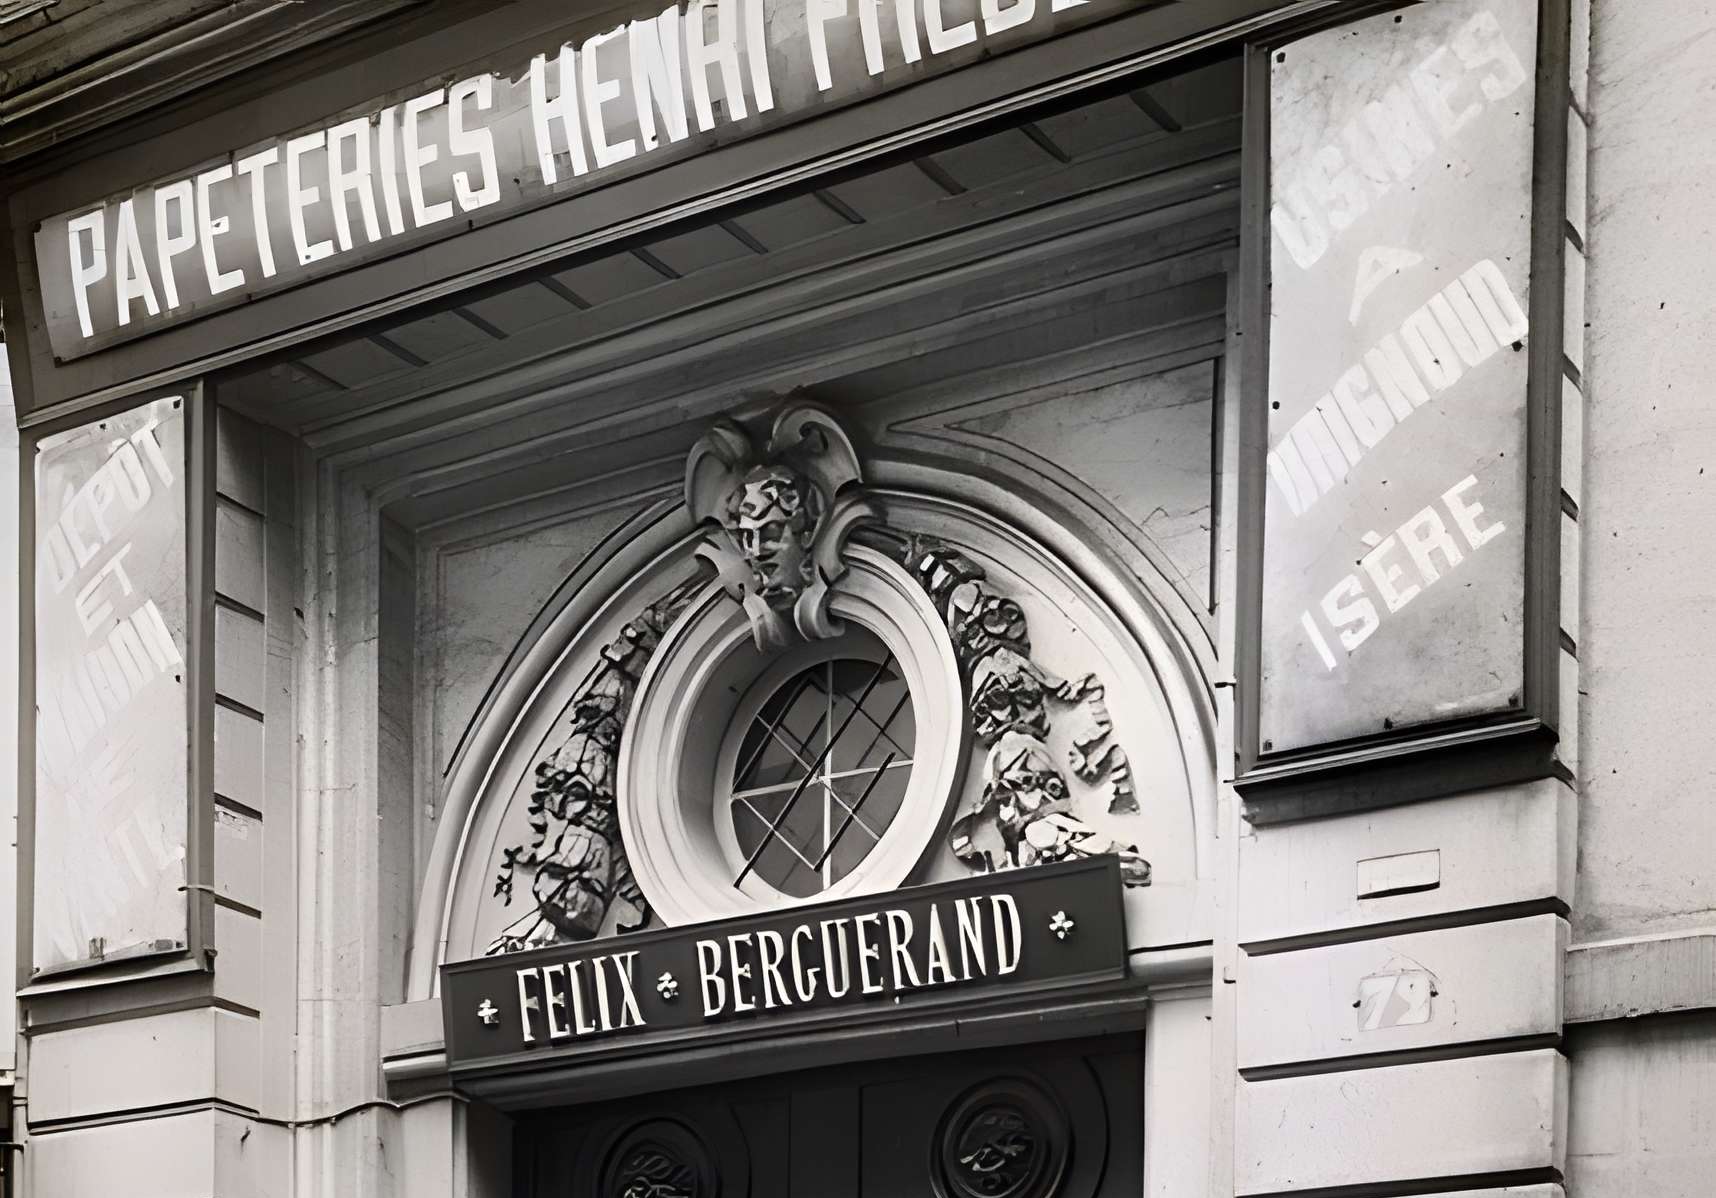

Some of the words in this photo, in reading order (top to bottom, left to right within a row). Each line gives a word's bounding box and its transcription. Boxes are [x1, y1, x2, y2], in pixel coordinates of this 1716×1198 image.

[68, 73, 501, 338] PAPETERIES
[528, 0, 774, 186] HENRI
[1300, 473, 1506, 672] ISÈRE
[516, 950, 647, 1042] FELIX
[696, 894, 1022, 1018] BERGUERAND
